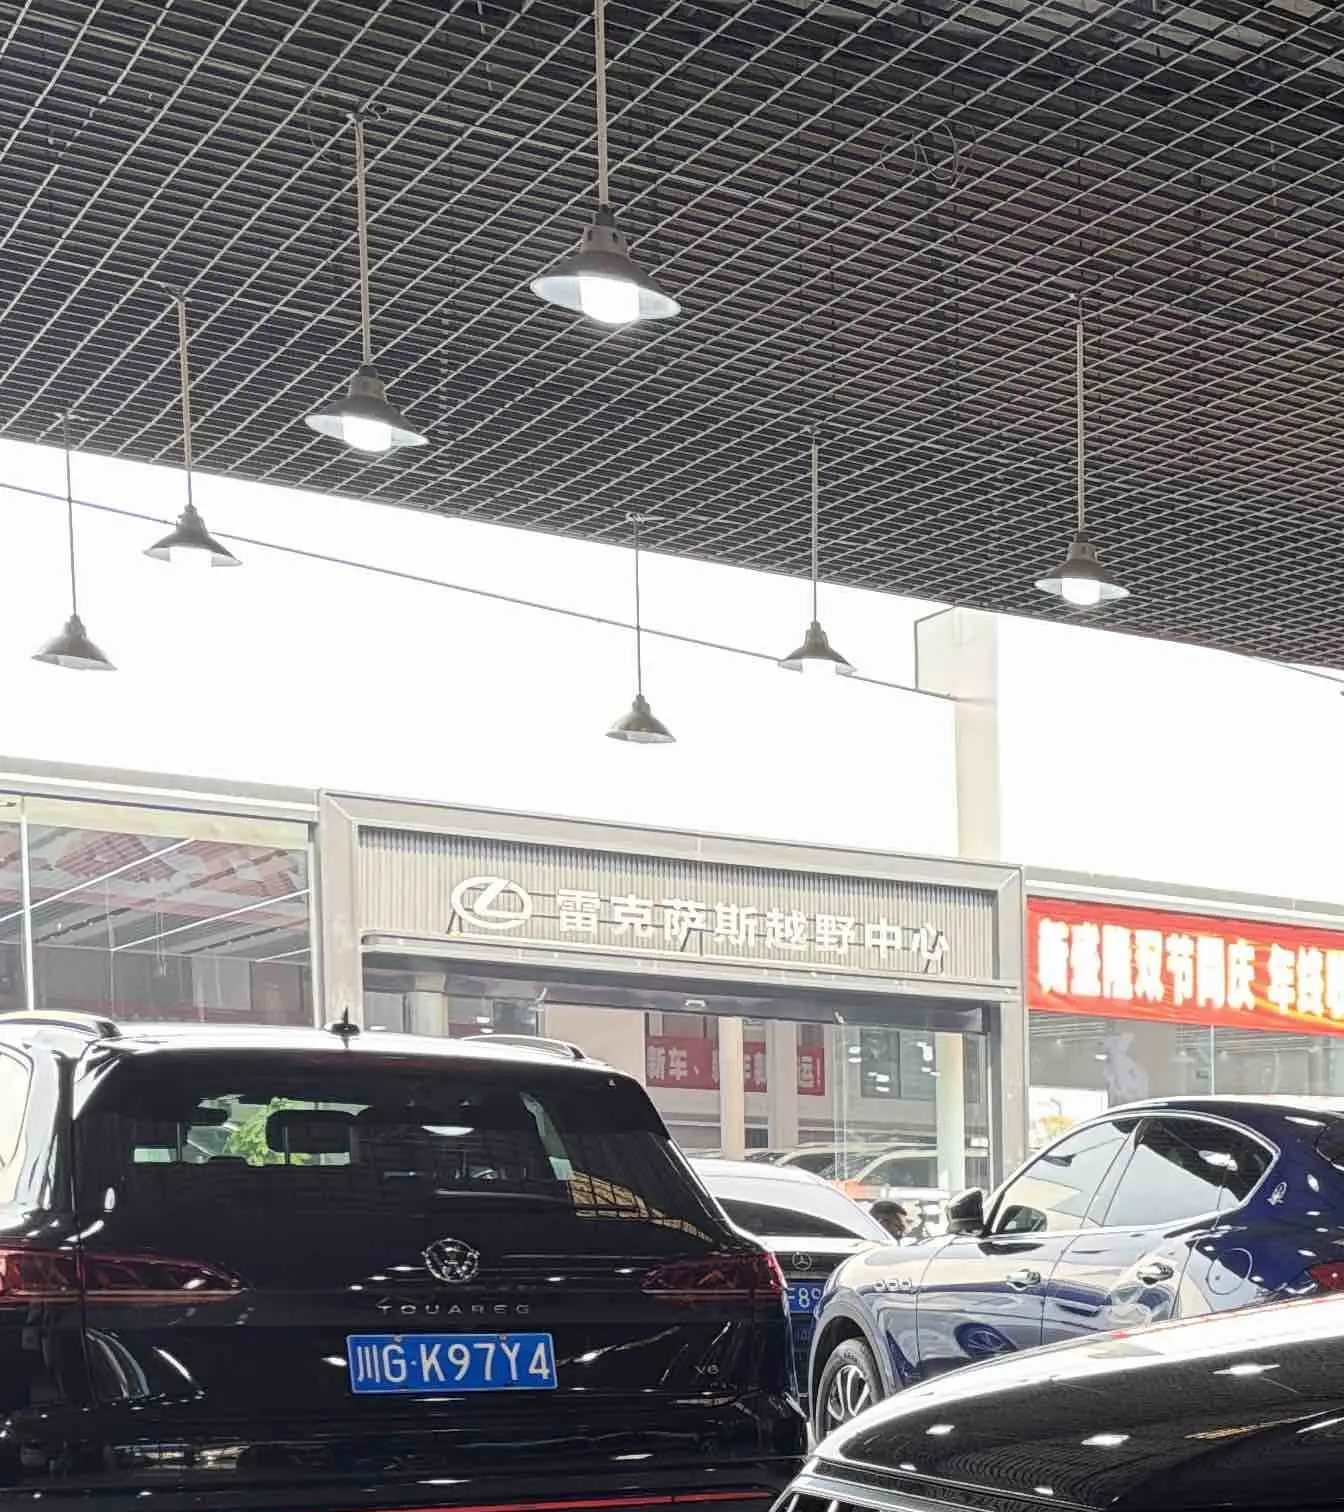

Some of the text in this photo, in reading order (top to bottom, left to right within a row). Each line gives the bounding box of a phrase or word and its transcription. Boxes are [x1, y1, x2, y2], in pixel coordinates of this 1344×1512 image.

[556, 888, 950, 962] 雷克萨斯越野中心
[376, 1303, 530, 1315] TOUAREG
